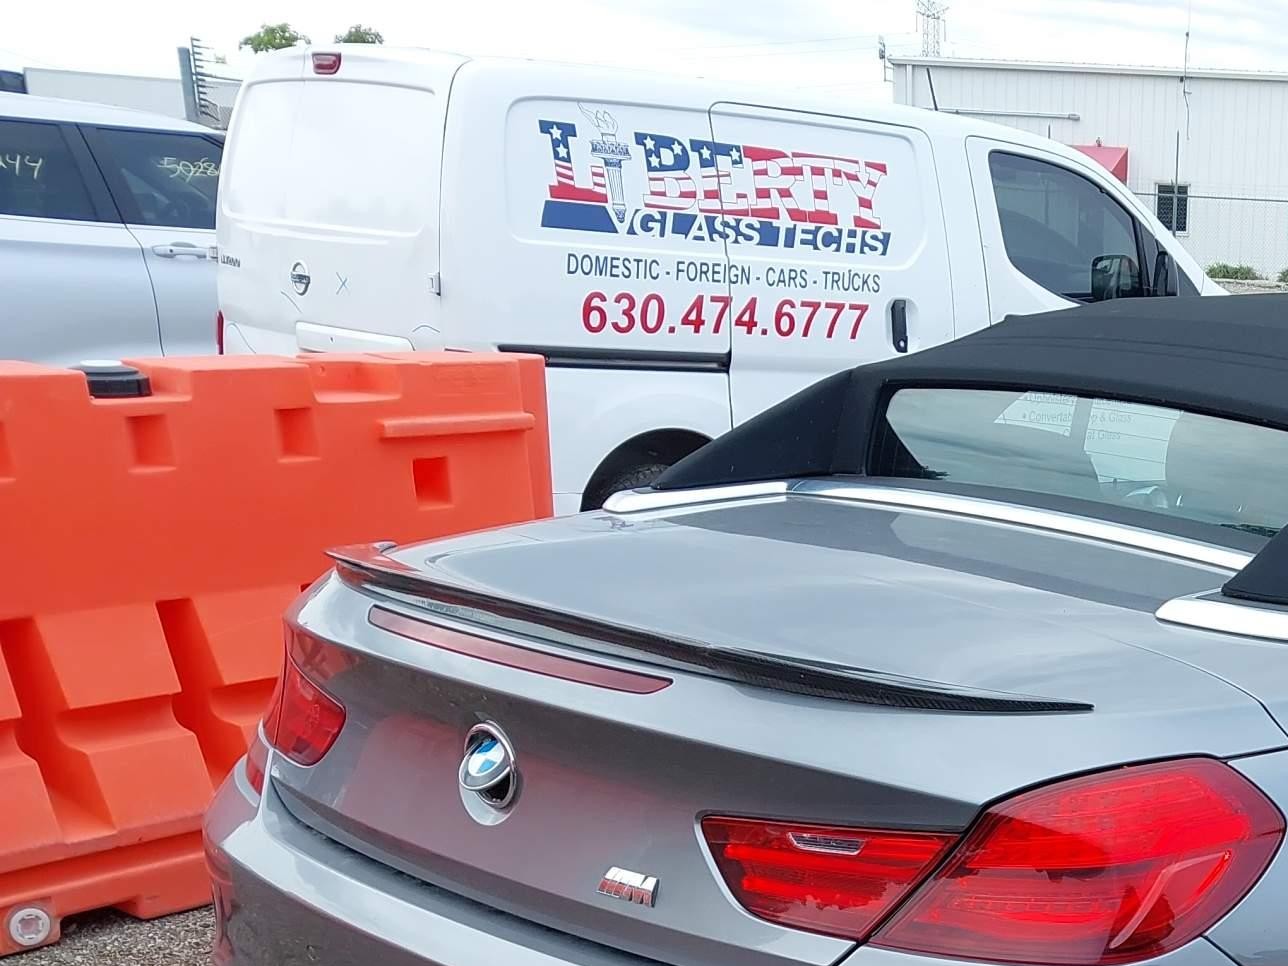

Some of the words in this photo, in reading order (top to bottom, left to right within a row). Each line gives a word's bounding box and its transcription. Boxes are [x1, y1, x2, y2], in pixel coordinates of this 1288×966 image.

[537, 118, 888, 231] LIBERTY
[632, 209, 761, 246] GLASS
[770, 221, 886, 257] TECHS
[566, 252, 661, 281] DOMESTIC
[675, 260, 751, 286] FOREIGN
[765, 266, 808, 289] CARS
[821, 269, 882, 294] TRUCKS
[581, 290, 870, 341] 630.474.6777
